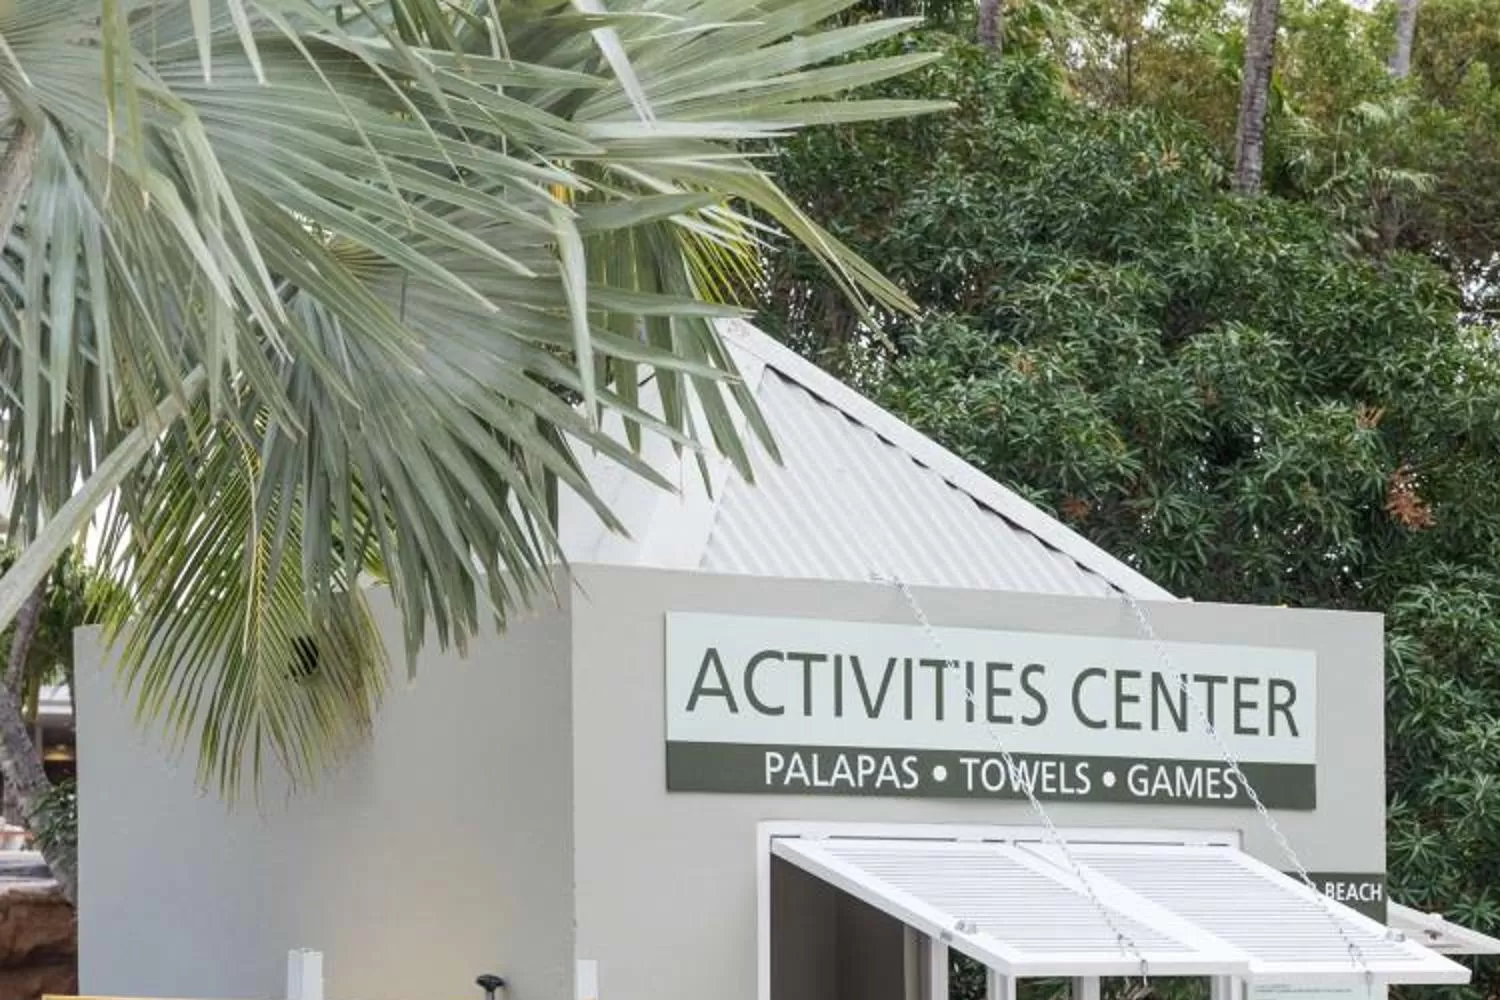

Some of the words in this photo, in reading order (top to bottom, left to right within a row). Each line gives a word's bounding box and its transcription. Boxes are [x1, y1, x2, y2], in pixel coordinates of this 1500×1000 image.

[686, 648, 1049, 727] ACTIVITIES
[1071, 668, 1300, 738] CENTER
[765, 751, 919, 790] PALAPAS
[960, 758, 1092, 793] TOWELS
[1127, 763, 1239, 799] GAMES
[1324, 881, 1383, 902] BEACH
